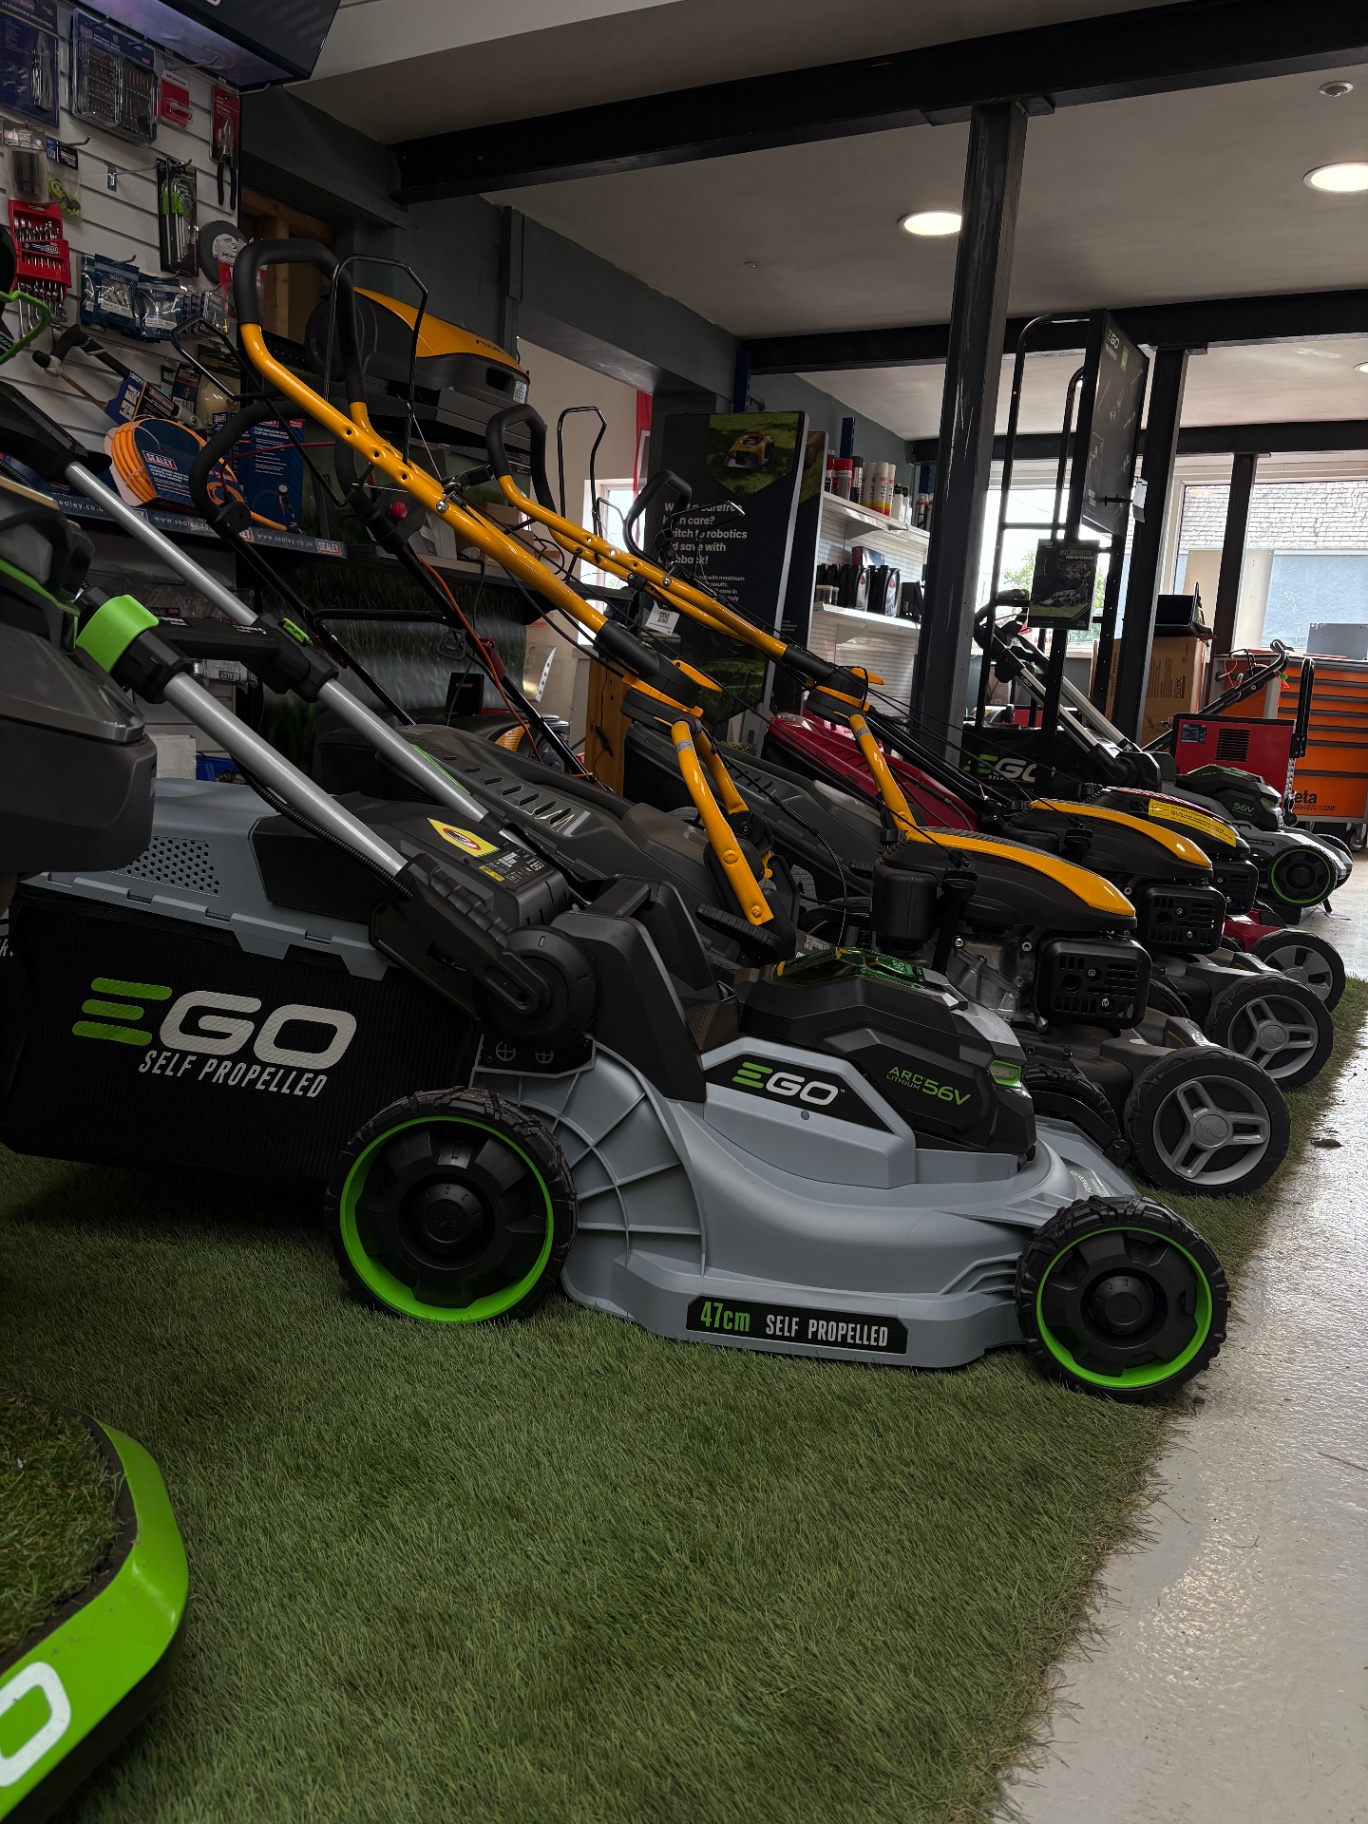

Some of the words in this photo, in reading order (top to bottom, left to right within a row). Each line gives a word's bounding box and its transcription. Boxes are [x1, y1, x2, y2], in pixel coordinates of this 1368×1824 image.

[146, 451, 175, 468] SEALEY
[664, 502, 691, 512] Wt
[662, 515, 686, 525] ln
[687, 515, 715, 525] care?
[256, 532, 313, 547] www.sealey.co.uk
[672, 528, 693, 538] itch
[706, 528, 748, 539] robotics
[318, 541, 340, 554] SEALEY
[705, 541, 727, 552] with
[1294, 789, 1318, 804] eta
[1232, 802, 1255, 814] 56V
[71, 976, 358, 1071] EGO
[138, 1049, 197, 1078] SELF
[197, 1057, 328, 1099] PROPELLED
[731, 1061, 840, 1107] EGO
[885, 1073, 921, 1091] LITHIUM
[888, 1066, 924, 1085] ARC
[921, 1079, 972, 1106] 56V
[700, 1300, 751, 1332] 47cm
[765, 1313, 800, 1338] SELF
[807, 1318, 889, 1347] PROPELLED
